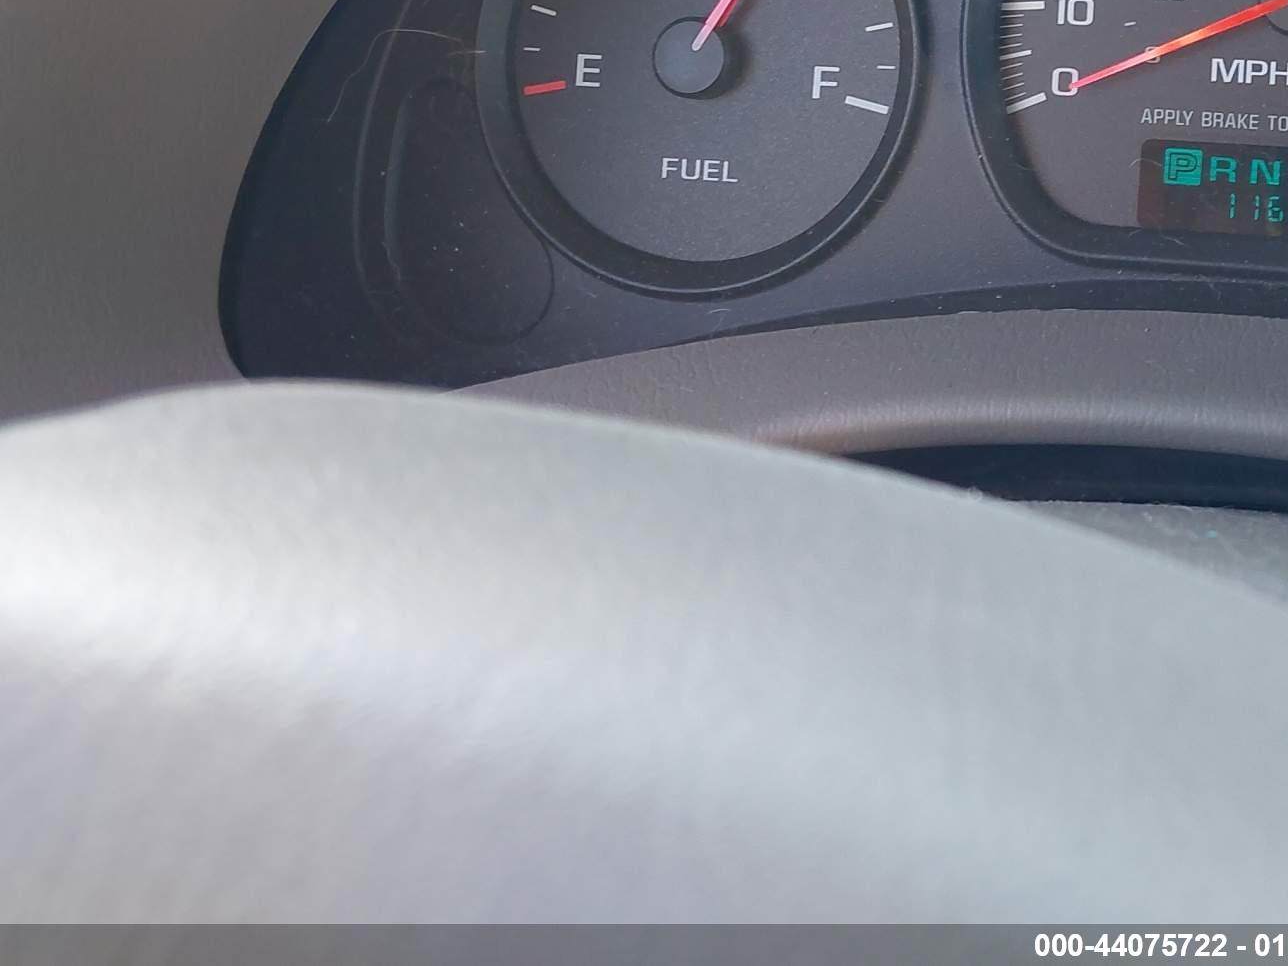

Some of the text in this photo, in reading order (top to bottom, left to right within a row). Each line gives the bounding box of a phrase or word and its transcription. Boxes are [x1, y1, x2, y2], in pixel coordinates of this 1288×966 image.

[575, 53, 602, 87] E
[812, 65, 840, 99] F
[1051, 68, 1079, 97] 0
[1140, 109, 1194, 126] APPLY
[1201, 112, 1260, 131] BRAKE
[660, 157, 739, 183] FUEL
[1167, 152, 1198, 179] P
[1209, 156, 1238, 182] R
[1250, 159, 1281, 186] N
